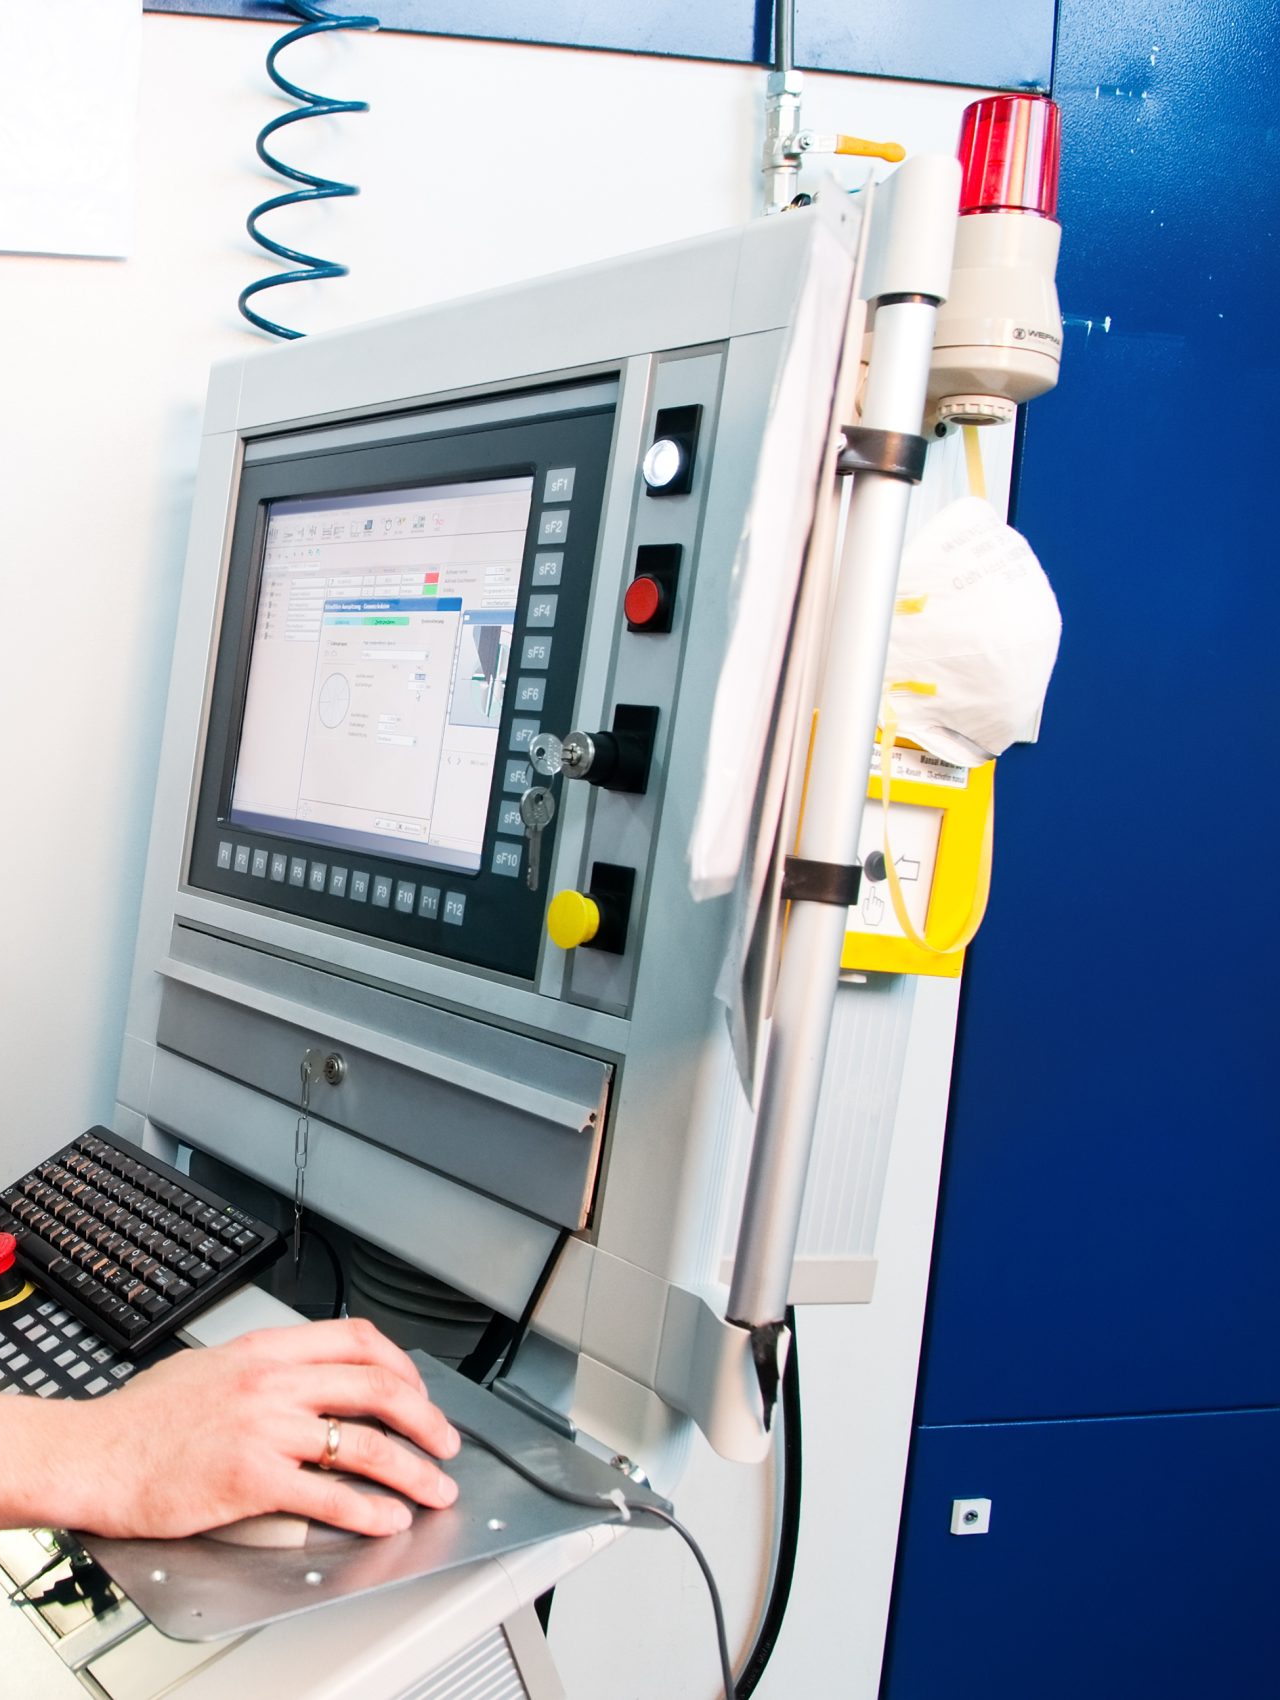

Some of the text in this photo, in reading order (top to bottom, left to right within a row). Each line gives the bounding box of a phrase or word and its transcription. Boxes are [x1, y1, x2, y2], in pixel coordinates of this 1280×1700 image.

[551, 478, 568, 492] sF1
[544, 520, 563, 534] sF2
[538, 563, 557, 575] sF3
[533, 604, 551, 617] sF4
[527, 646, 545, 659] sF5
[521, 688, 539, 700] sF6
[516, 729, 533, 742] sF7
[510, 770, 527, 784] sF8
[504, 812, 520, 825] sF9
[496, 854, 518, 867] sF10
[221, 851, 462, 916] F1 F2 F3 F4 F5 F6 F7 F8 F9 F10 F11 F12
